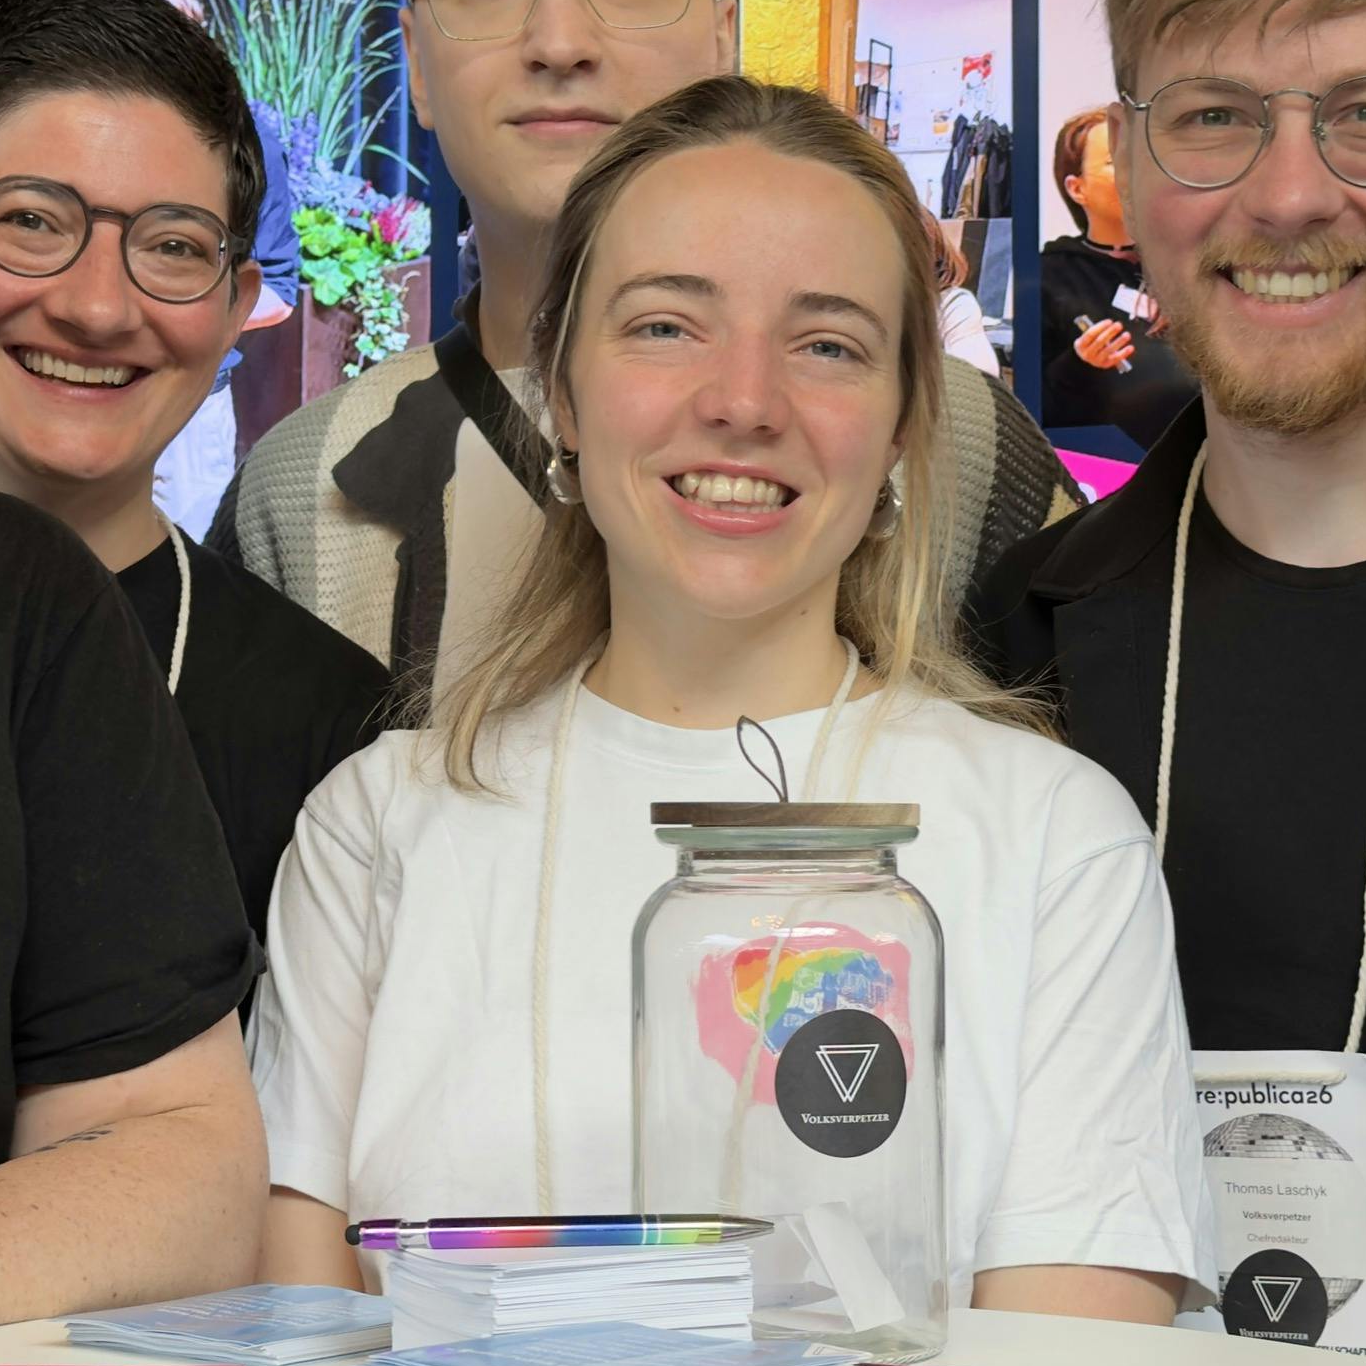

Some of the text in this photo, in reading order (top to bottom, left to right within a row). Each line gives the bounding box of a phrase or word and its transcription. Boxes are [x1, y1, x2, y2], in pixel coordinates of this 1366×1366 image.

[1195, 1081, 1333, 1109] re:publica26
[1225, 1182, 1328, 1199] Thomas Laschyk
[1242, 1210, 1312, 1222] Volksverpetzer
[1247, 1234, 1310, 1245] Chefredakteur
